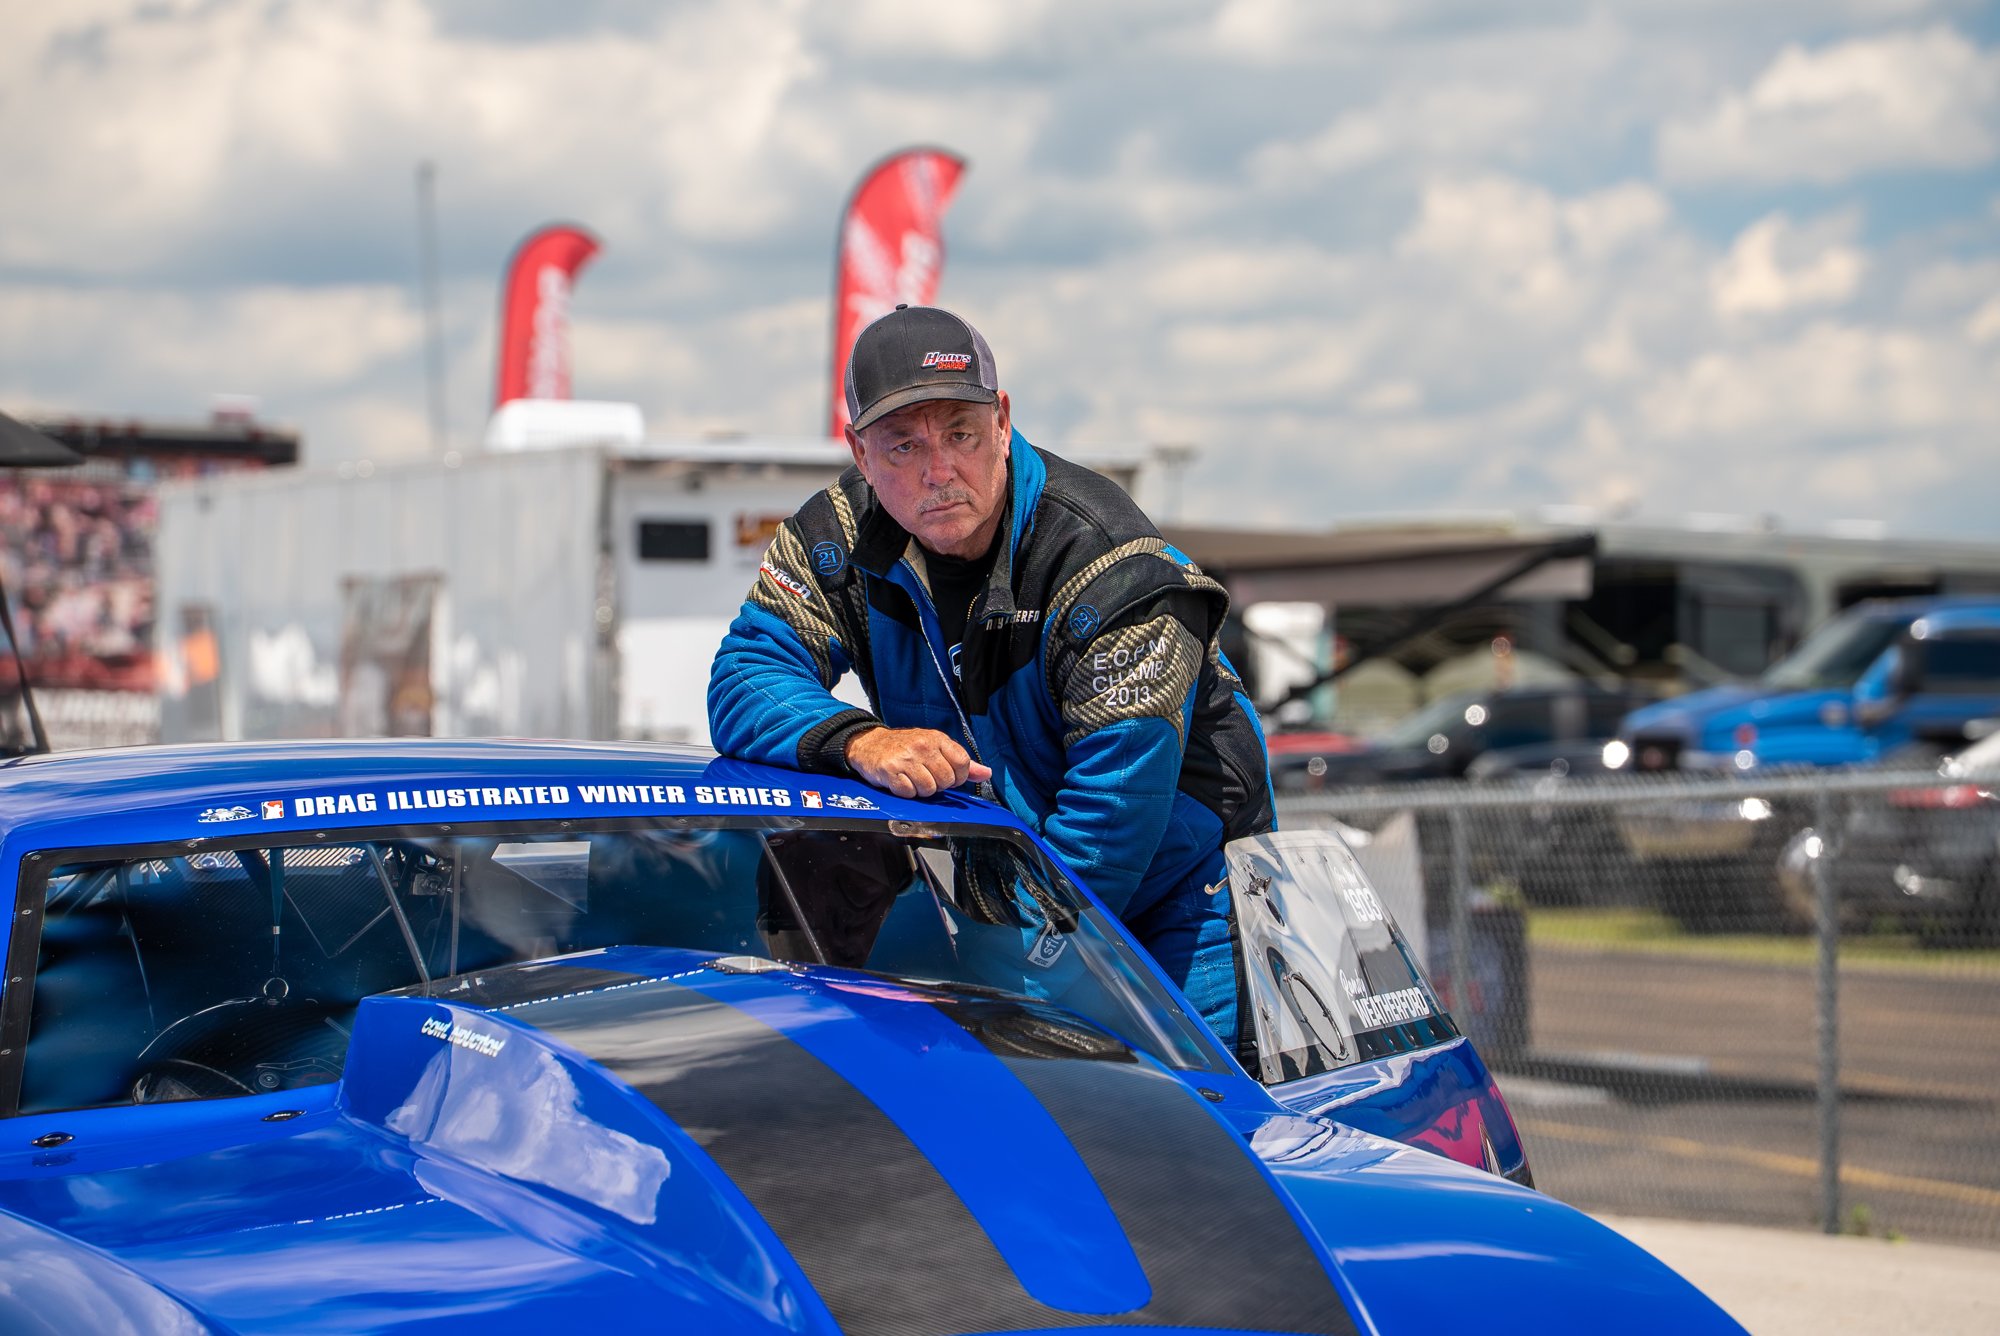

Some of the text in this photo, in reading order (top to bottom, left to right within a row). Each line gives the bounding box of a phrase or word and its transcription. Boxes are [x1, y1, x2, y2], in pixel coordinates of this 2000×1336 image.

[818, 550, 838, 567] 21
[1092, 659, 1164, 694] CHAMP
[1105, 684, 1153, 707] 2013
[295, 784, 791, 817] DRAG ILLUSTRATED WINTER SERIES
[1343, 887, 1383, 922] 1903
[1352, 986, 1430, 1028] WEATHERFORD
[421, 1016, 453, 1039] COWL
